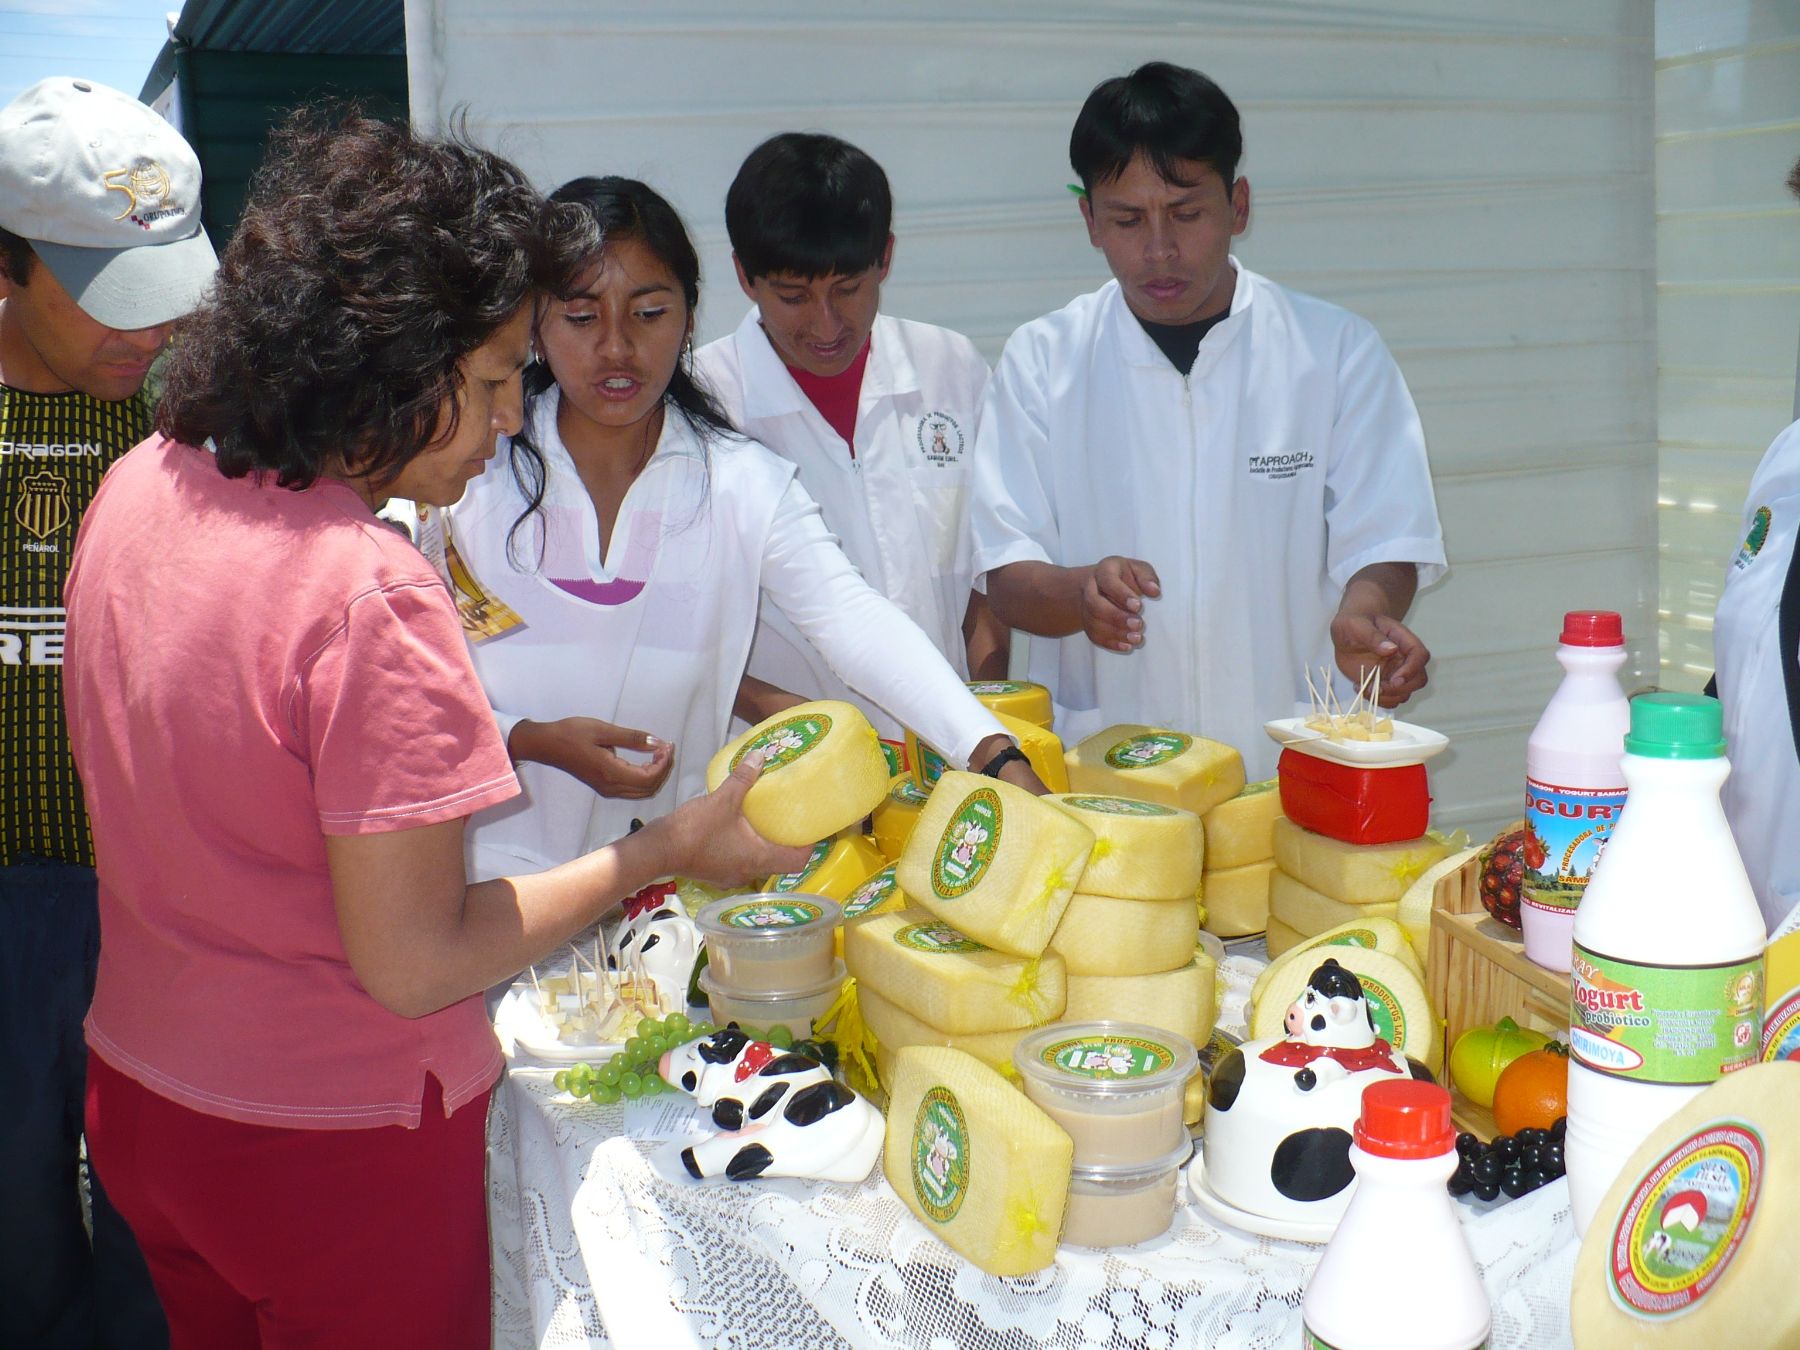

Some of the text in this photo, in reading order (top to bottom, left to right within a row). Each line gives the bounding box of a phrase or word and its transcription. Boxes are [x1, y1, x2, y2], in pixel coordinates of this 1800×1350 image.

[22, 543, 60, 553] PEÑAROL
[1596, 824, 1606, 833] DE
[1362, 980, 1401, 1022] PRODUCTOS
[1585, 1011, 1650, 1026] probiotico
